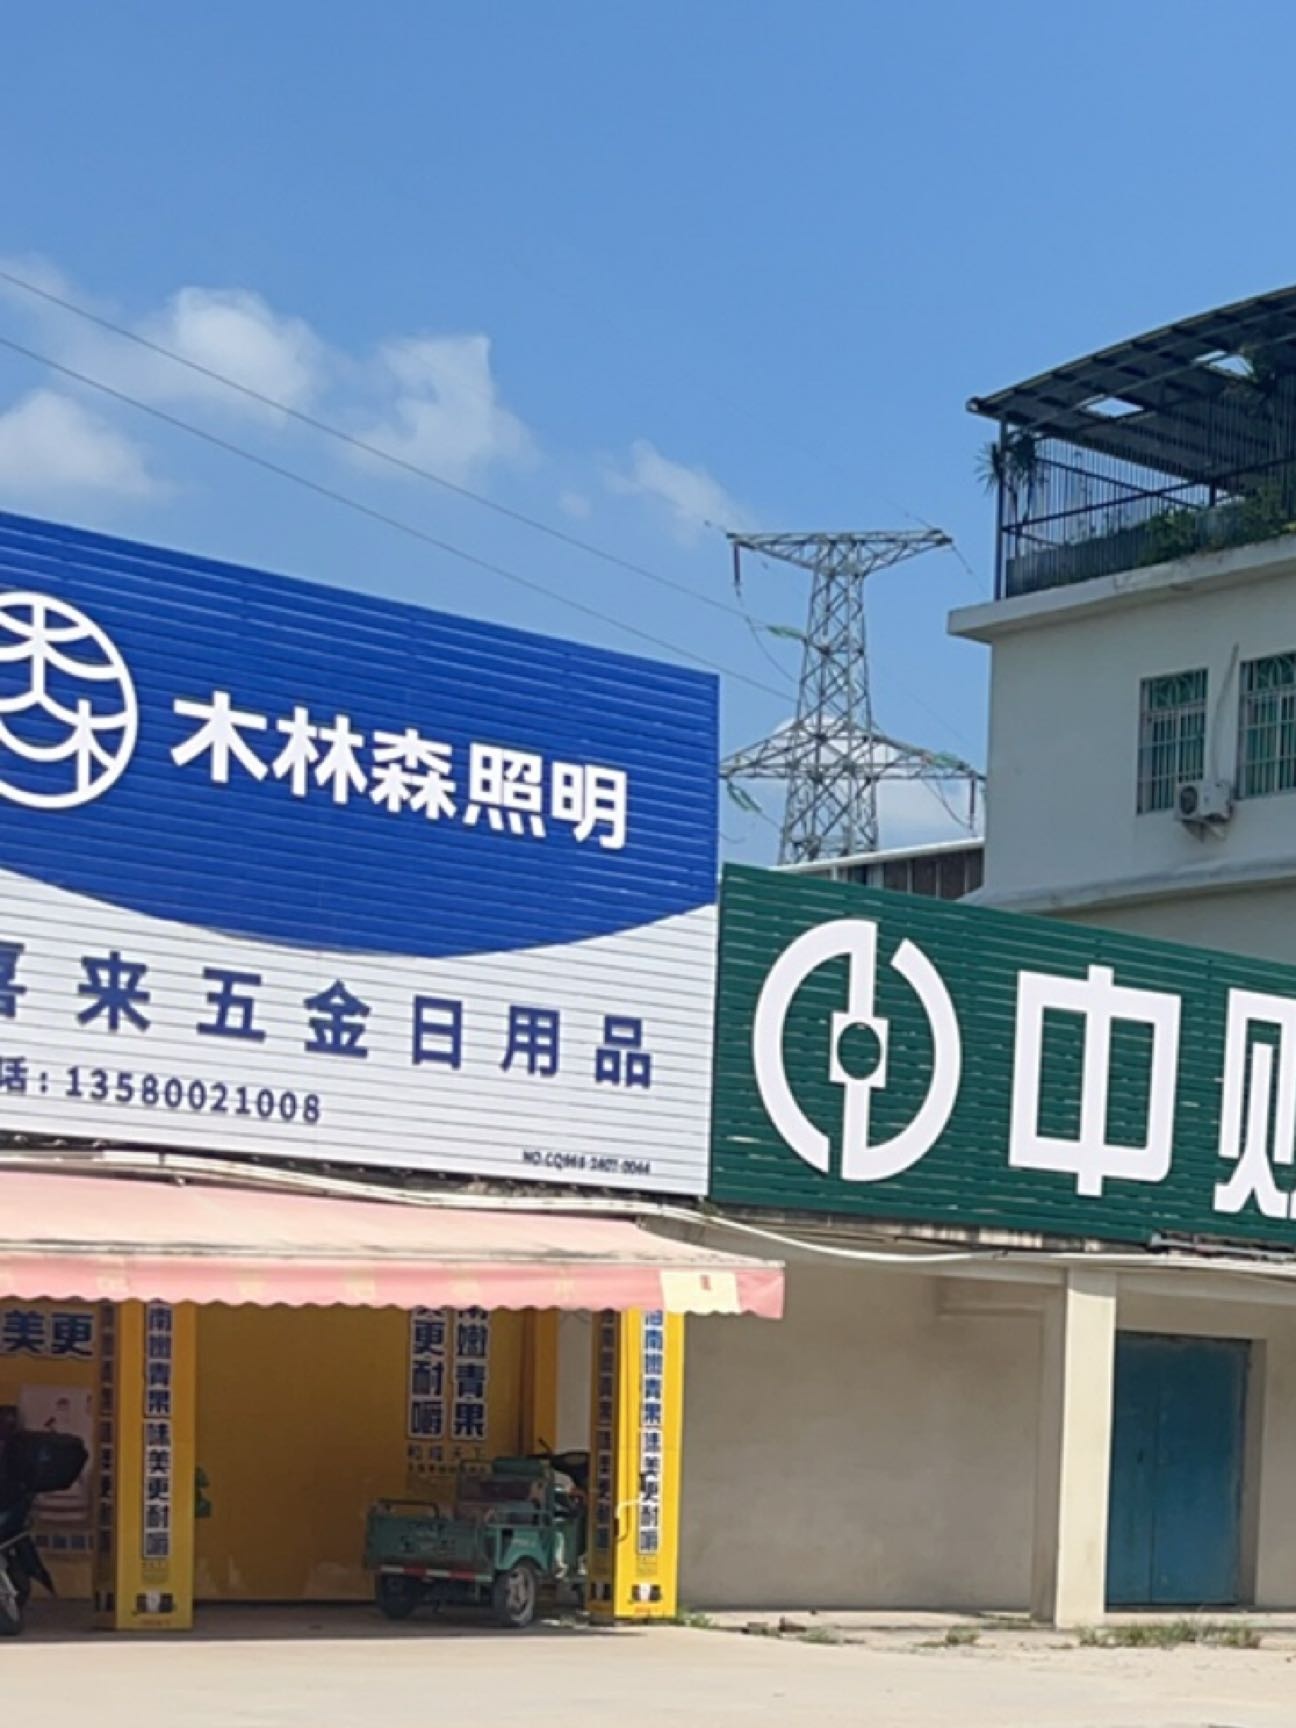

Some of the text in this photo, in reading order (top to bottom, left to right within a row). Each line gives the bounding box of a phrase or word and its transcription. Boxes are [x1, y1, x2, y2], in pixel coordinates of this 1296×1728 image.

[170, 690, 628, 849] 木林森照明
